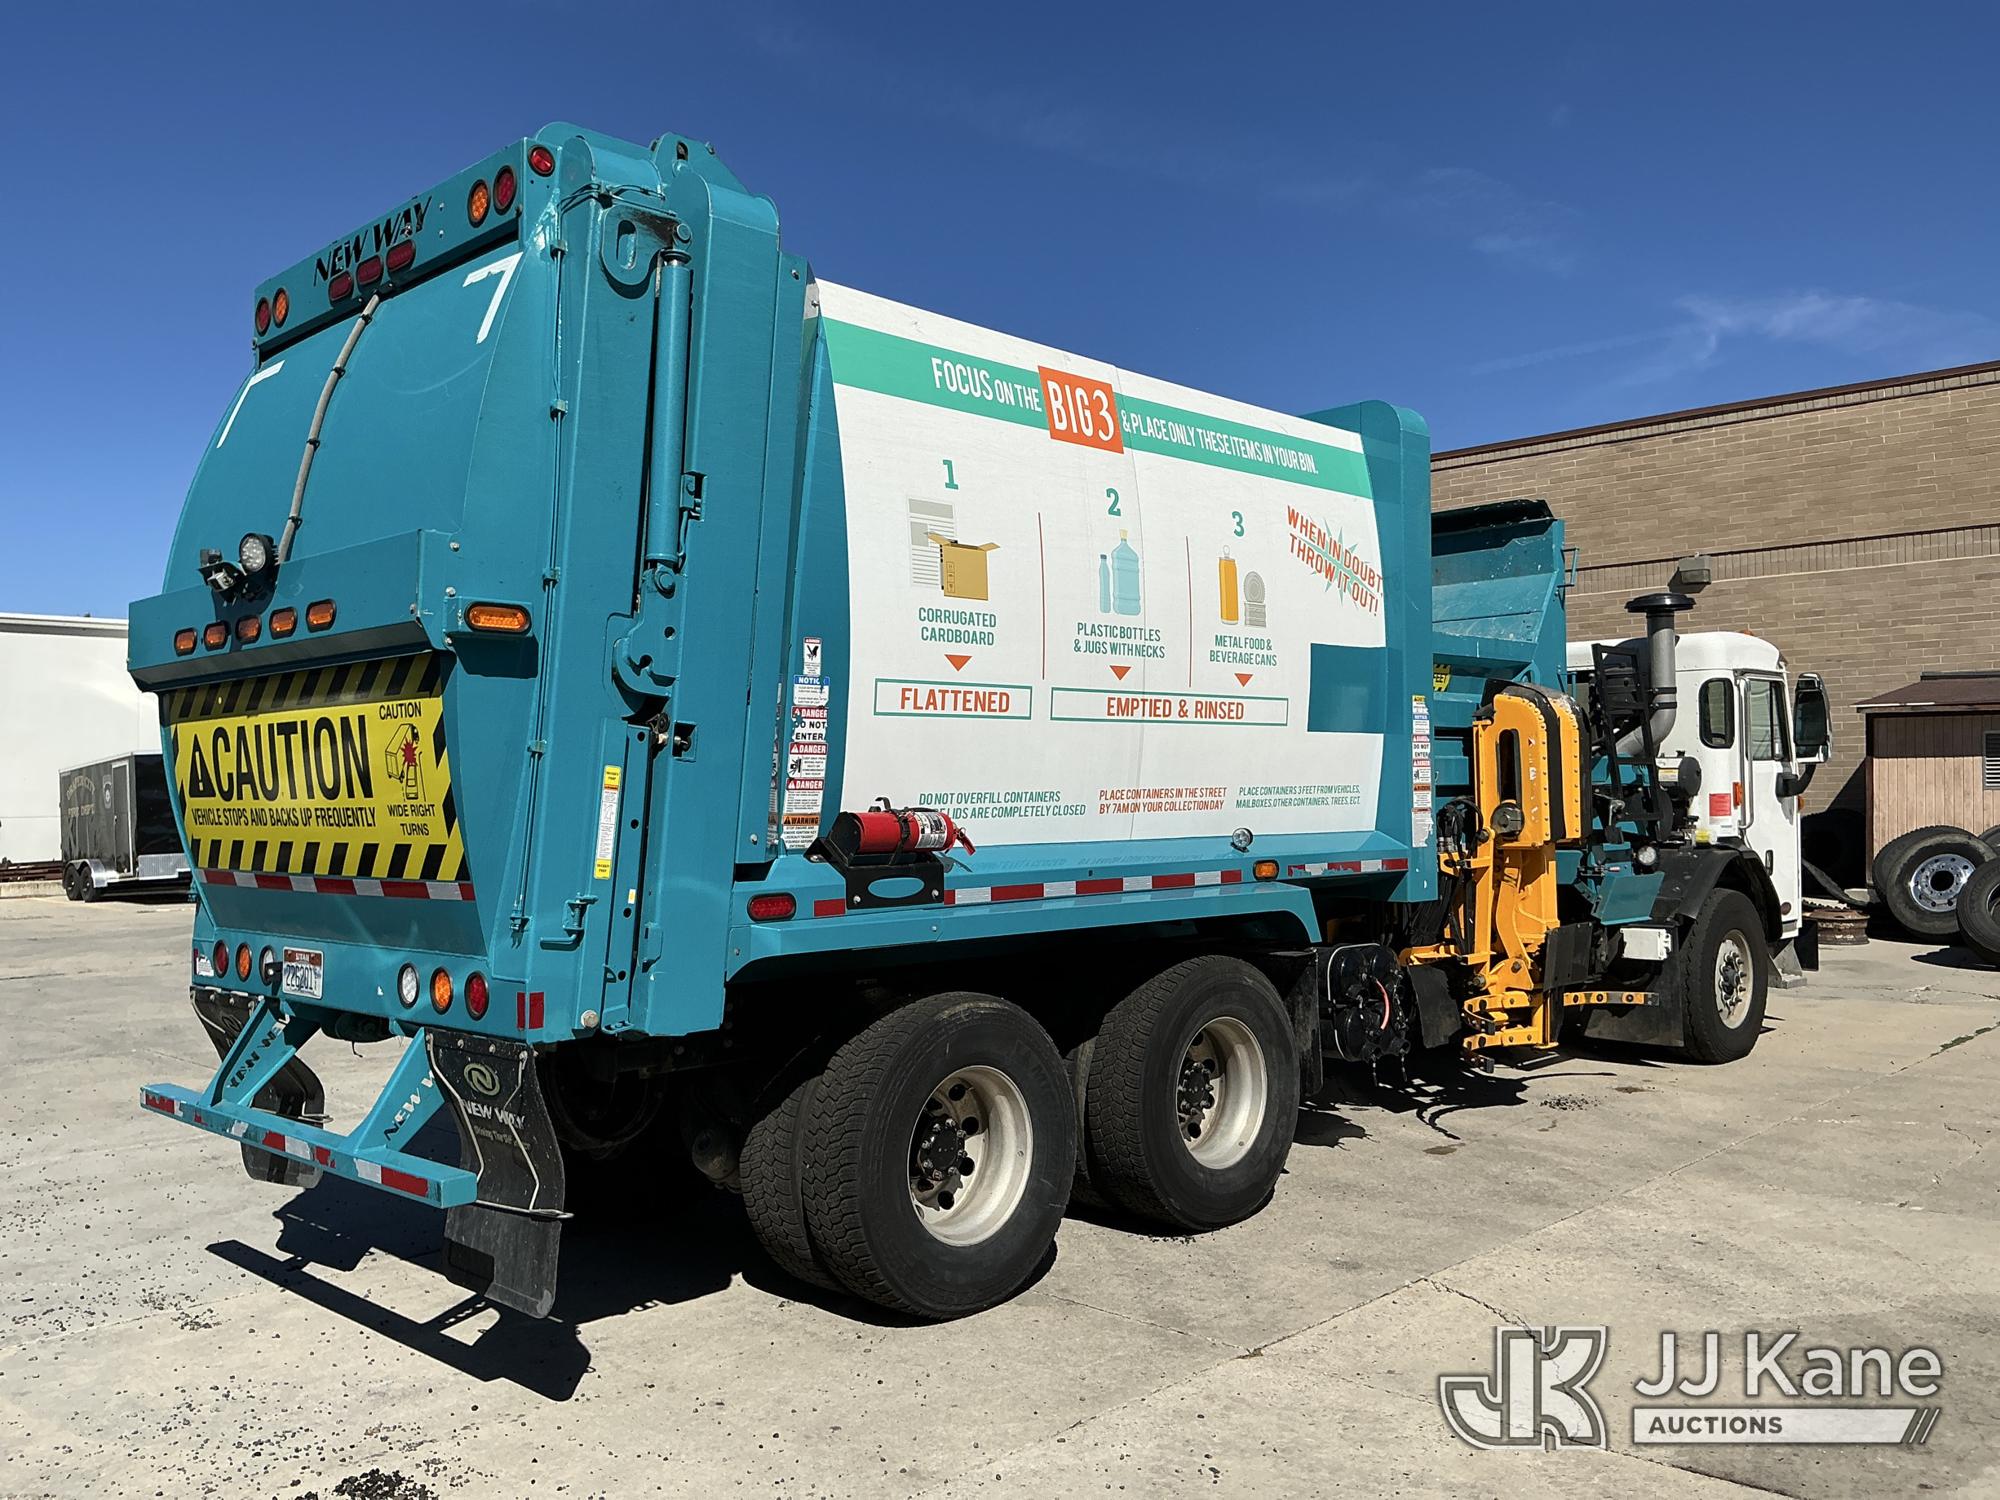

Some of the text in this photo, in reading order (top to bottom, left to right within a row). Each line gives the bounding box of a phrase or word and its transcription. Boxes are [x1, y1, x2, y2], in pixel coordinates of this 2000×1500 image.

[313, 195, 432, 287] NEW WAY
[931, 357, 1319, 474] FOCUS ON THE BIG 3 & PLACE ONLY THESE ITEMS IN YOUR BIN.
[943, 459, 959, 490] 1
[1106, 488, 1121, 516] 2
[1232, 511, 1245, 537] 3
[1287, 505, 1383, 597] WHEN IN DOUBT,
[1290, 533, 1378, 616] THROW IT OUT!
[918, 607, 997, 627] CORRUGATED
[921, 627, 994, 645] CARDBOARD
[1077, 622, 1161, 642] PLASTIC BOTTLES
[1073, 639, 1165, 658] & JUGS WITH NECKS
[1215, 635, 1273, 651] METAL FOOD &
[1209, 650, 1278, 666] BEVERAGE CANS
[798, 677, 821, 685] NOTIC
[901, 687, 1010, 713] FLATTENED
[1106, 697, 1244, 720] EMPTIED & RINSED
[379, 701, 421, 721] CAUTION
[809, 721, 826, 729] NOT
[795, 732, 824, 740] ENTER
[212, 714, 373, 802] CAUTION
[799, 744, 826, 755] DANGER
[795, 779, 823, 789] DANGER
[1239, 786, 1260, 796] PLACE
[1260, 785, 1297, 796] CONTAINERS
[1297, 785, 1302, 794] 3
[1302, 785, 1316, 795] FEET
[1316, 785, 1333, 794] FROM
[919, 790, 1061, 806] DO NOT OVERFILL CONTAINERS
[1099, 786, 1227, 801] PLACE CONTAINERS IN THE STREET
[387, 804, 436, 818] WIDE RIGHT
[970, 807, 990, 819] ARE
[991, 805, 1051, 818] COMPLETELY
[1052, 804, 1087, 816] CLOSED
[1099, 800, 1225, 814] BY 7AM ON YOUR COLLECTION DAY
[1273, 798, 1293, 808] OTHER
[192, 807, 376, 828] VEHICLE STOPS AND BACKS UP FREQUENTLY
[791, 817, 819, 825] WARNING
[400, 823, 430, 837] TURNS
[384, 1088, 421, 1141] NEW
[460, 1099, 492, 1120] NEW
